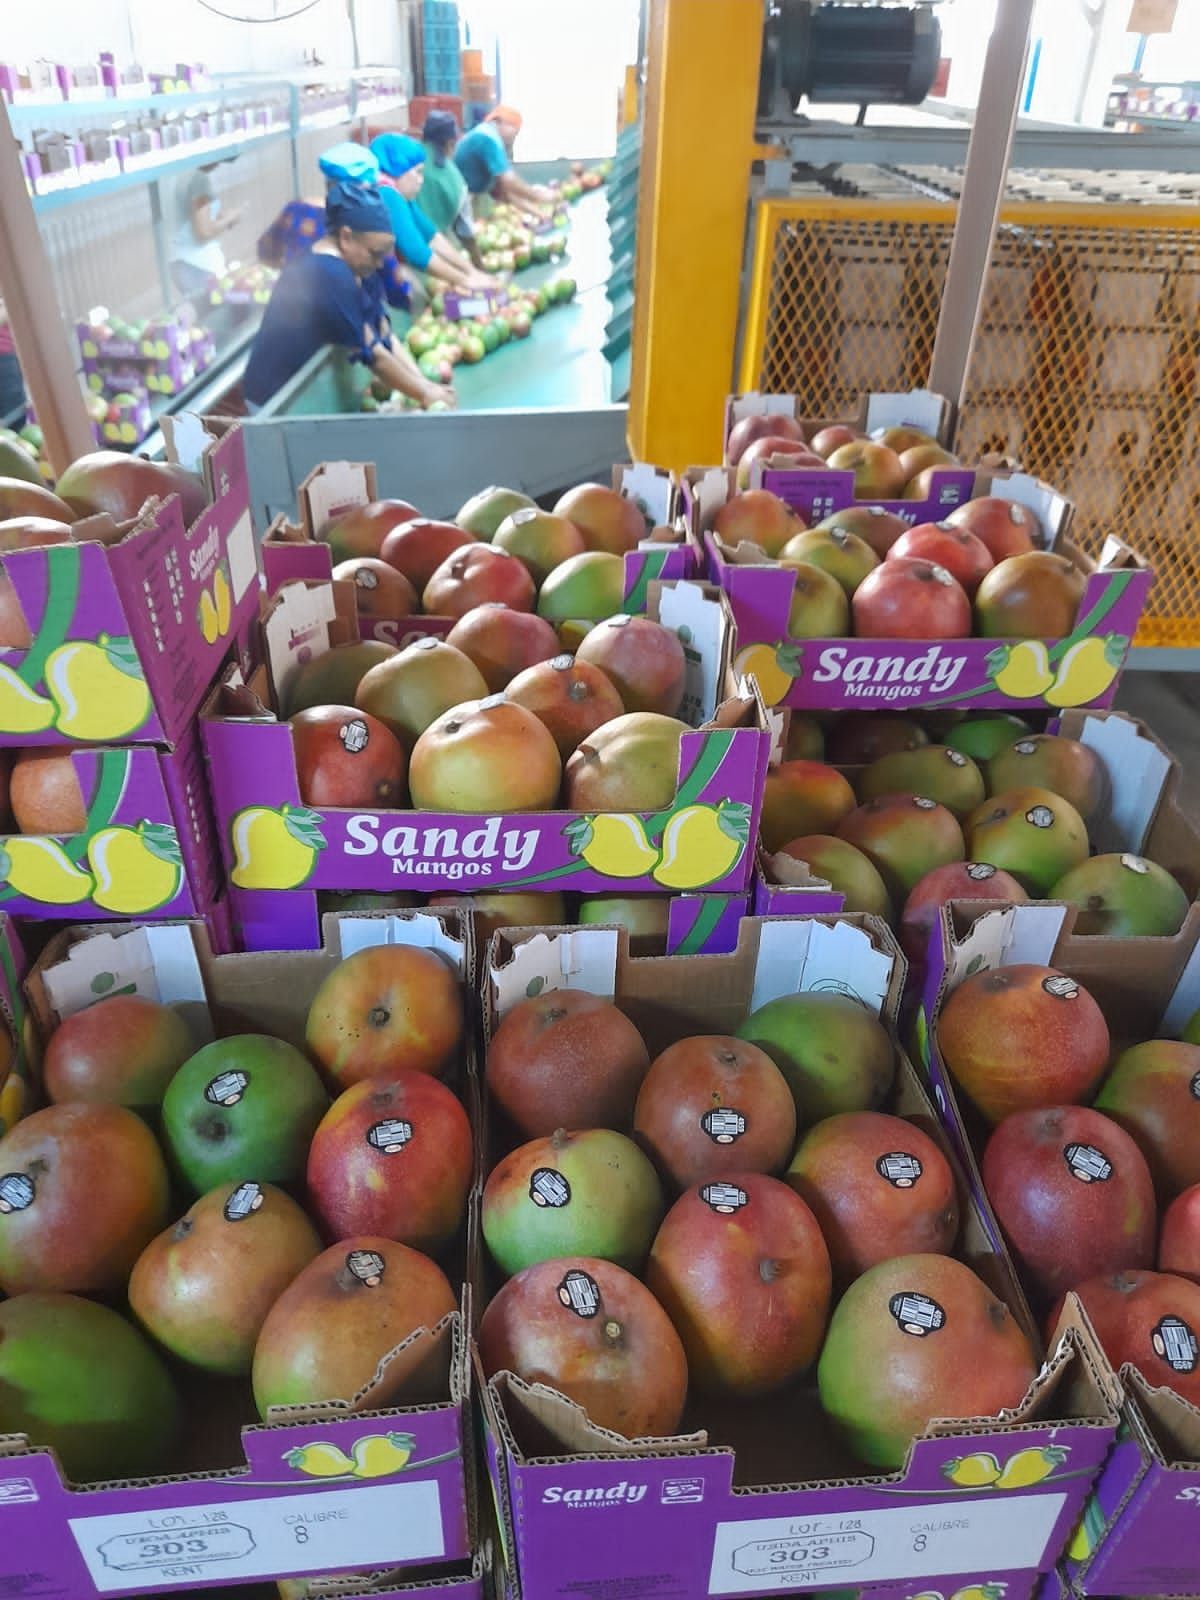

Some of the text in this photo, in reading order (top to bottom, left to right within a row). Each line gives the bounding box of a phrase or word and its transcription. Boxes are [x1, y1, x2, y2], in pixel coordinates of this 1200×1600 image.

[813, 646, 967, 692] Sandy
[844, 683, 922, 700] Mangos
[344, 815, 540, 871] Sandy
[392, 858, 492, 879] Mangos
[542, 1481, 648, 1503] Sandy
[148, 1515, 187, 1529] LOT
[203, 1511, 229, 1522] 128
[283, 1509, 350, 1525] CALIBRE
[909, 1518, 969, 1534] CALIBRE
[294, 1525, 309, 1544] 8
[789, 1522, 822, 1535] LOT
[839, 1519, 862, 1531] 128
[139, 1539, 208, 1558] 303
[912, 1534, 927, 1552] 8
[769, 1546, 830, 1563] 303
[160, 1565, 204, 1577] KENT
[780, 1571, 818, 1584] KENT
